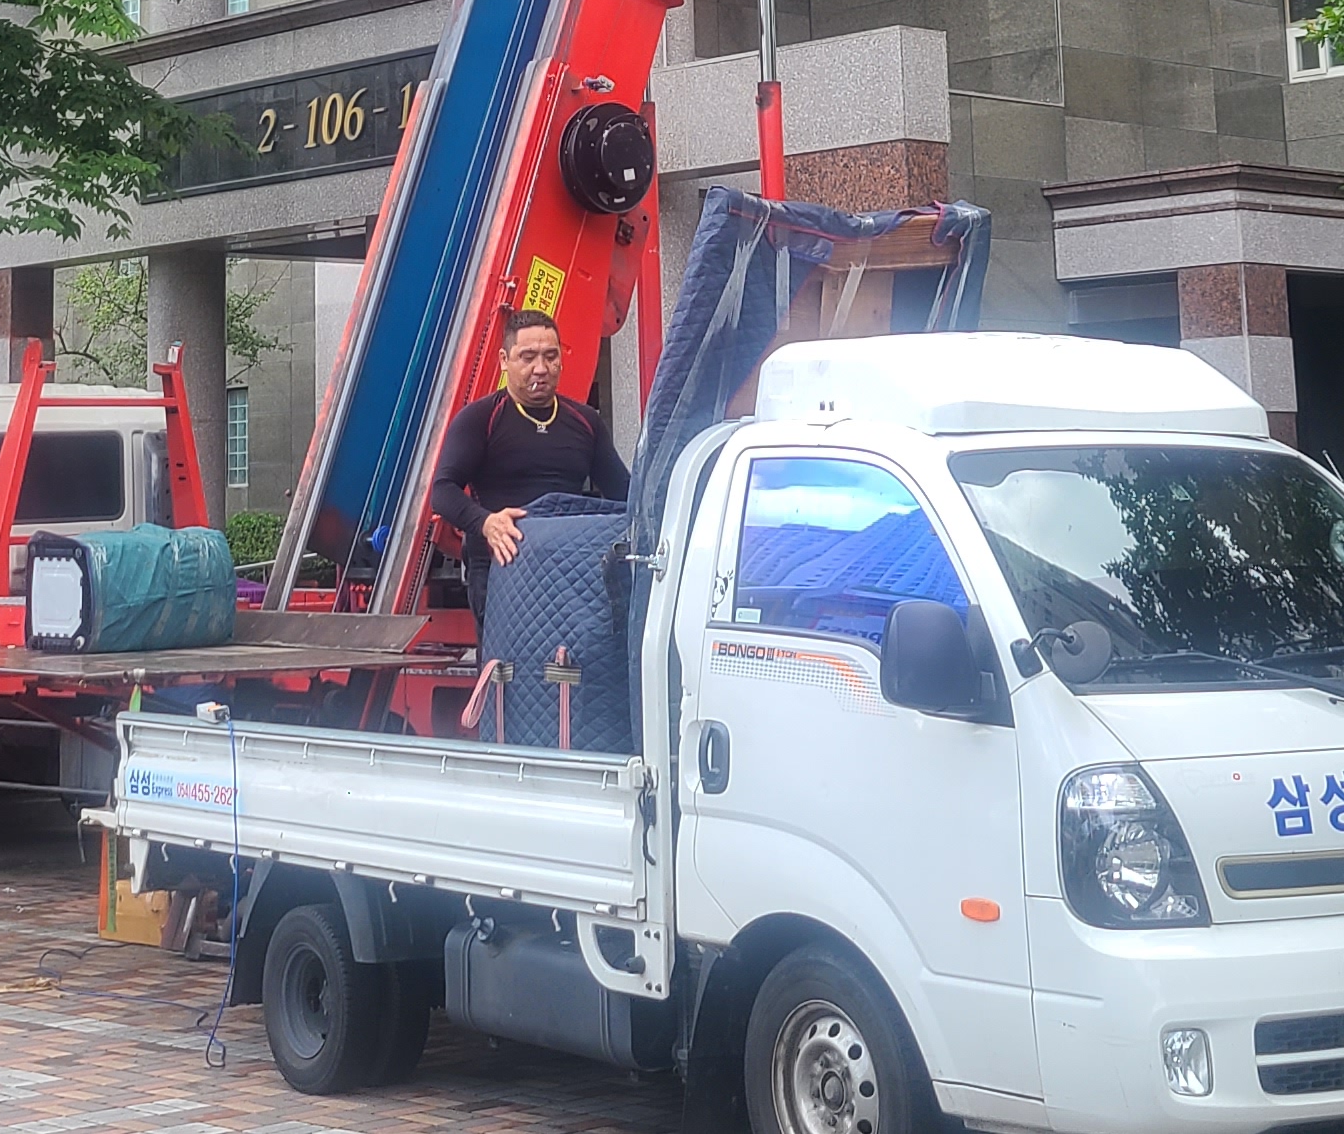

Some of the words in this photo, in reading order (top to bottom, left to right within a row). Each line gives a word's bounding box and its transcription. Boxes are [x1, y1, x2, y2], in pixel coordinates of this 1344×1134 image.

[538, 272, 558, 311] 대금지
[718, 643, 765, 659] BONGO
[130, 769, 152, 796] 삼성
[152, 782, 173, 798] Express
